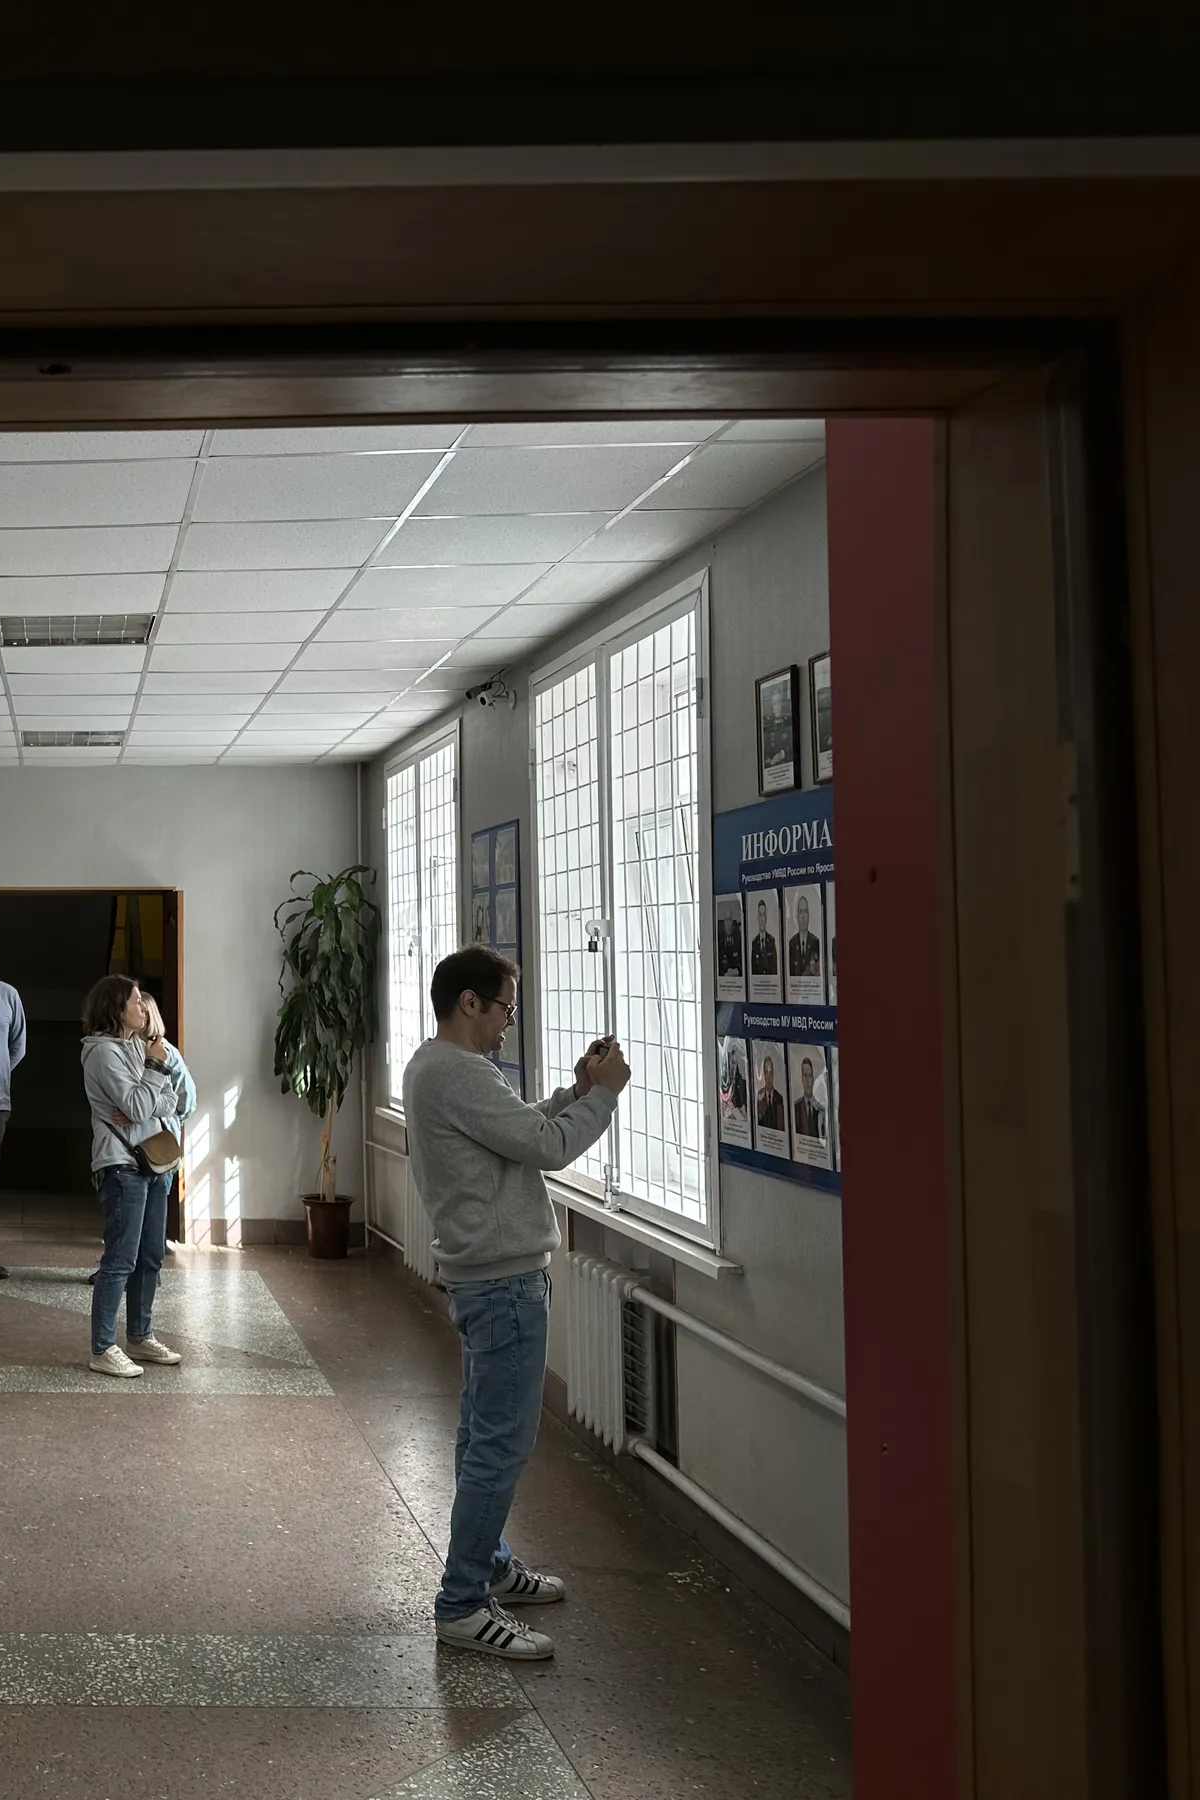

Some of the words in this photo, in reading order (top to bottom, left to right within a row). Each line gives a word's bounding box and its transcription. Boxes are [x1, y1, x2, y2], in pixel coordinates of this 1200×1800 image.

[741, 818, 833, 861] ИНФОРМА
[741, 872, 771, 885] Руководство
[787, 866, 807, 877] России
[807, 865, 815, 874] по
[743, 1013, 780, 1027] Руководство
[781, 1016, 790, 1028] МУ
[792, 1016, 807, 1031] МВД
[808, 1017, 834, 1031] России
